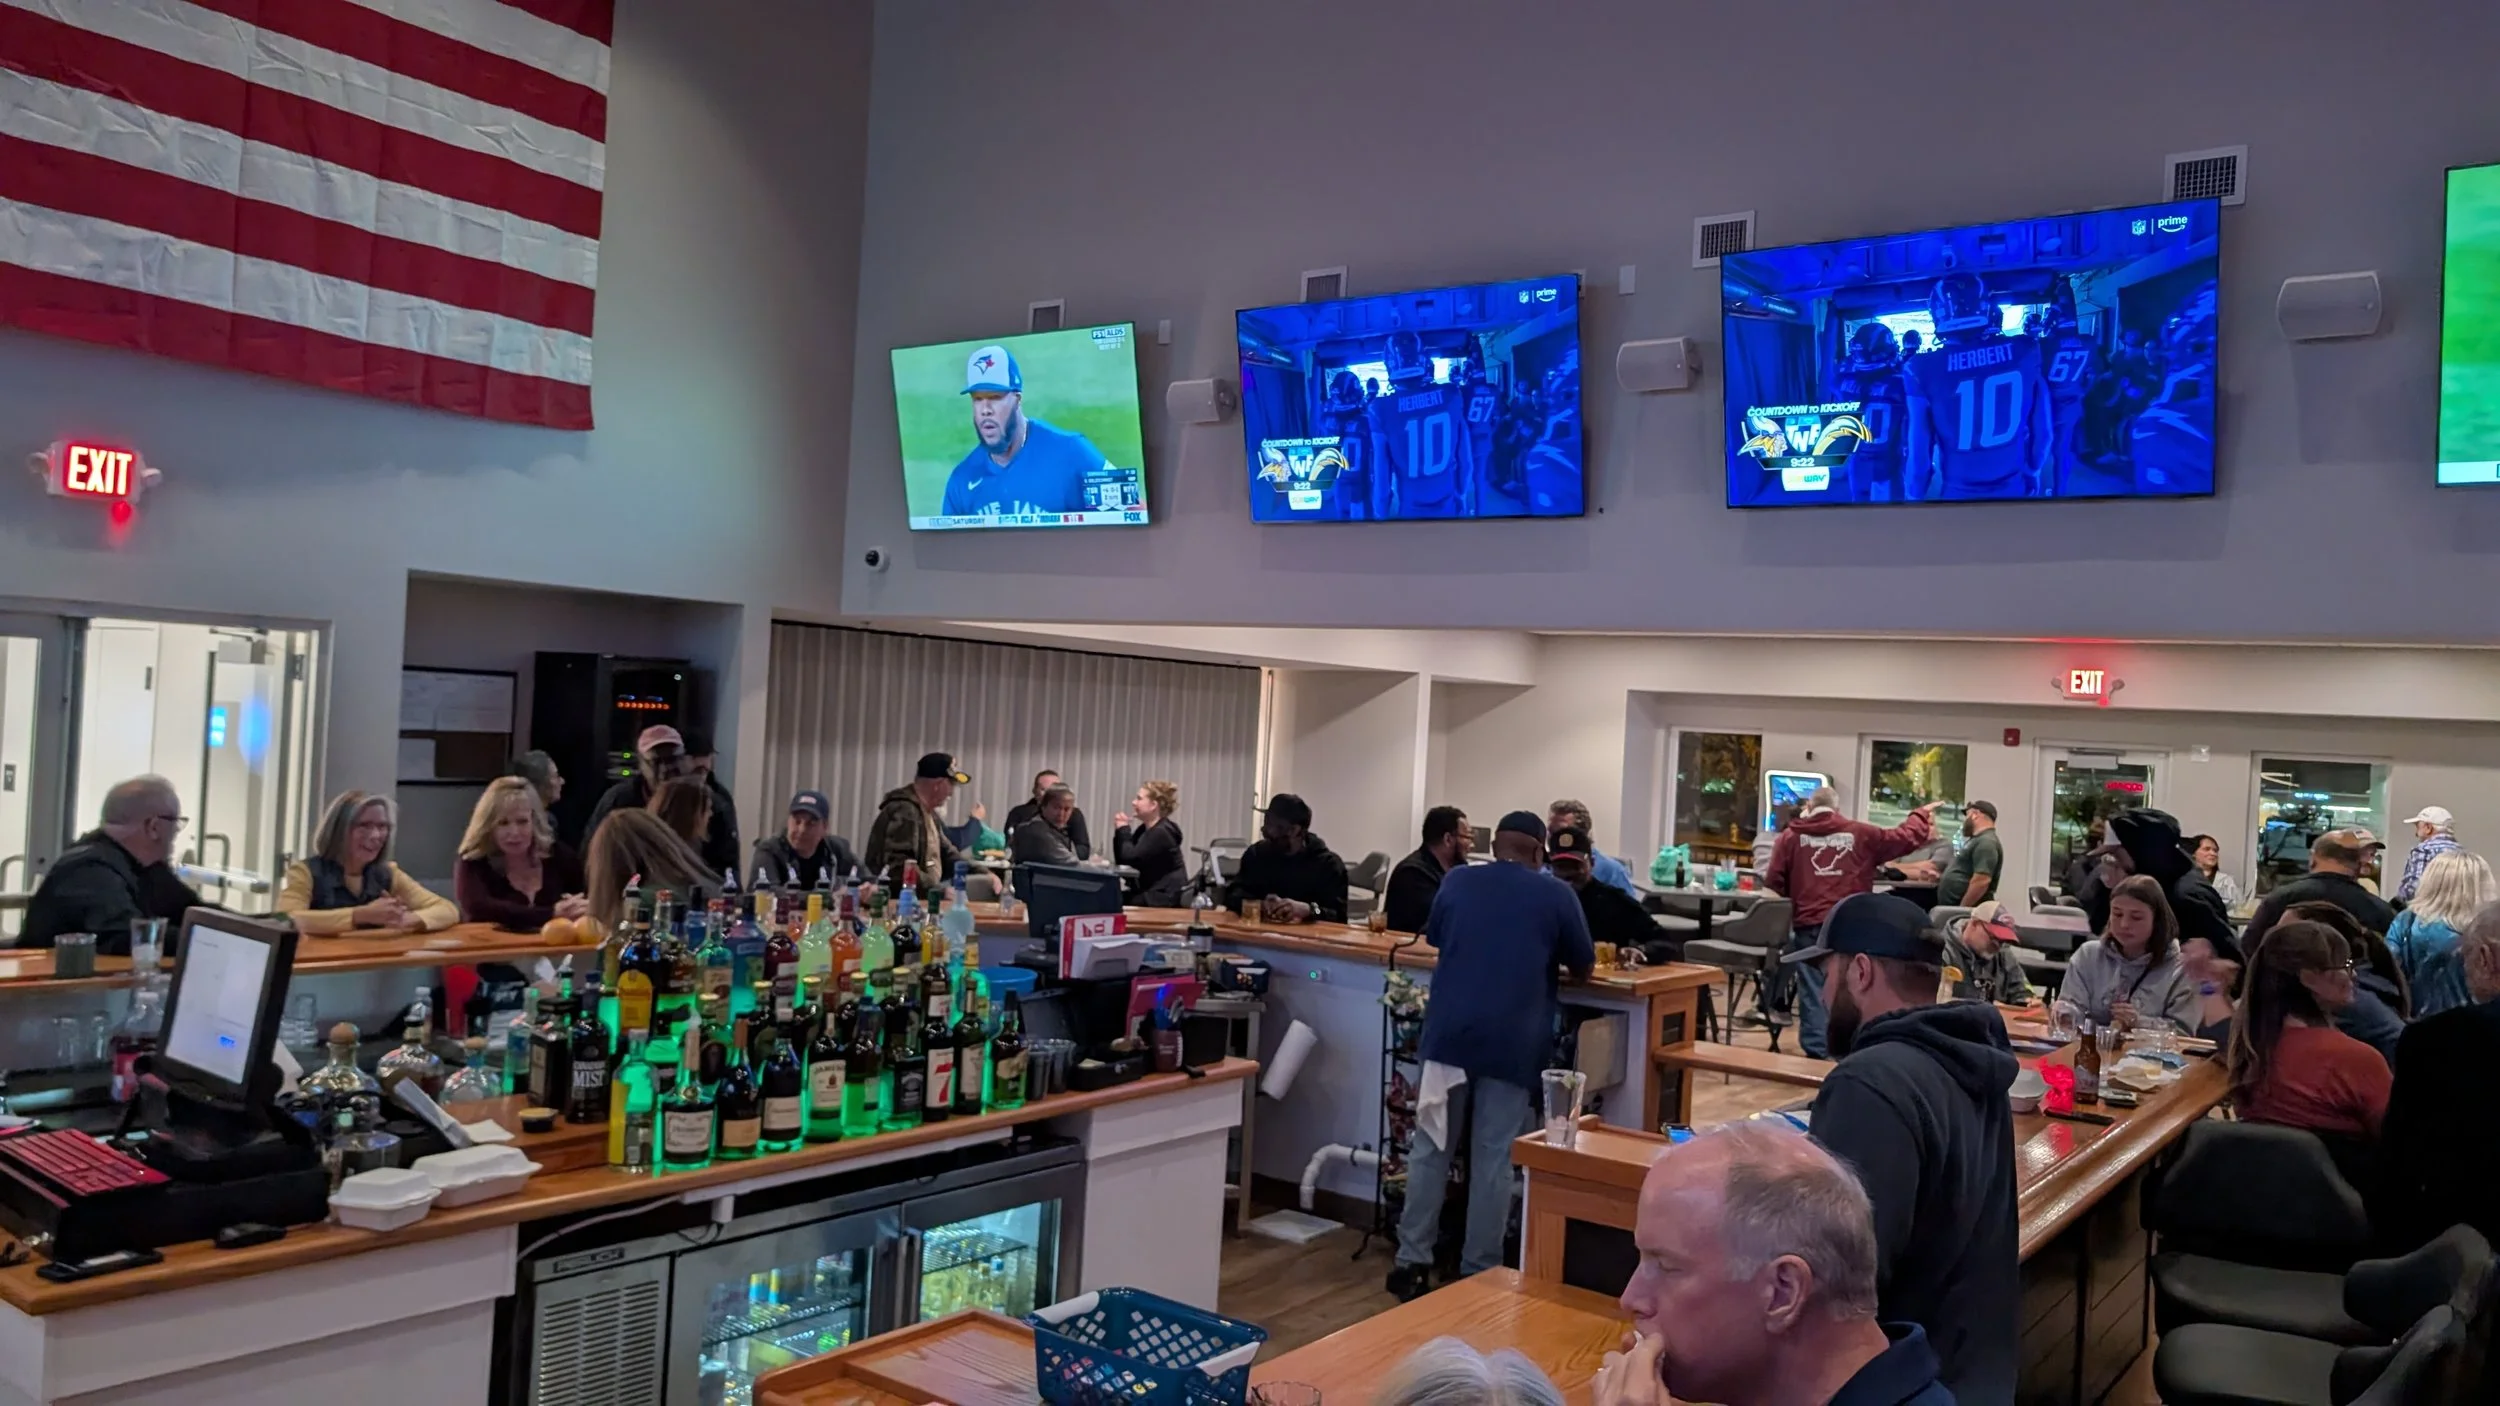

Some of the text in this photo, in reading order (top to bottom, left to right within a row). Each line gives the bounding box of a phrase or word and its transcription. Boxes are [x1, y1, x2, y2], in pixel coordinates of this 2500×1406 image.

[2158, 216, 2188, 228] prime
[1537, 288, 1557, 298] prime
[1948, 343, 2013, 371] HERBERT
[2048, 350, 2089, 382] 67
[1398, 389, 1443, 412] HERBERT
[1468, 396, 1495, 422] 67
[1747, 401, 1861, 417] COUNTDOWN TO KICKOFF
[1956, 370, 2022, 450] 10
[1262, 438, 1304, 448] COUNTDOWN
[1312, 436, 1340, 446] KICKOFF
[1405, 412, 1450, 478] 10
[1785, 423, 1820, 453] TNF
[68, 445, 133, 495] EXIT
[1791, 458, 1815, 467] 9:22
[1091, 494, 1133, 505] 1 1
[953, 517, 985, 525] SATURDAY
[1123, 512, 1141, 522] FOX
[2071, 670, 2104, 694] EXIT
[573, 1070, 605, 1087] MIST
[935, 1062, 953, 1103] 7
